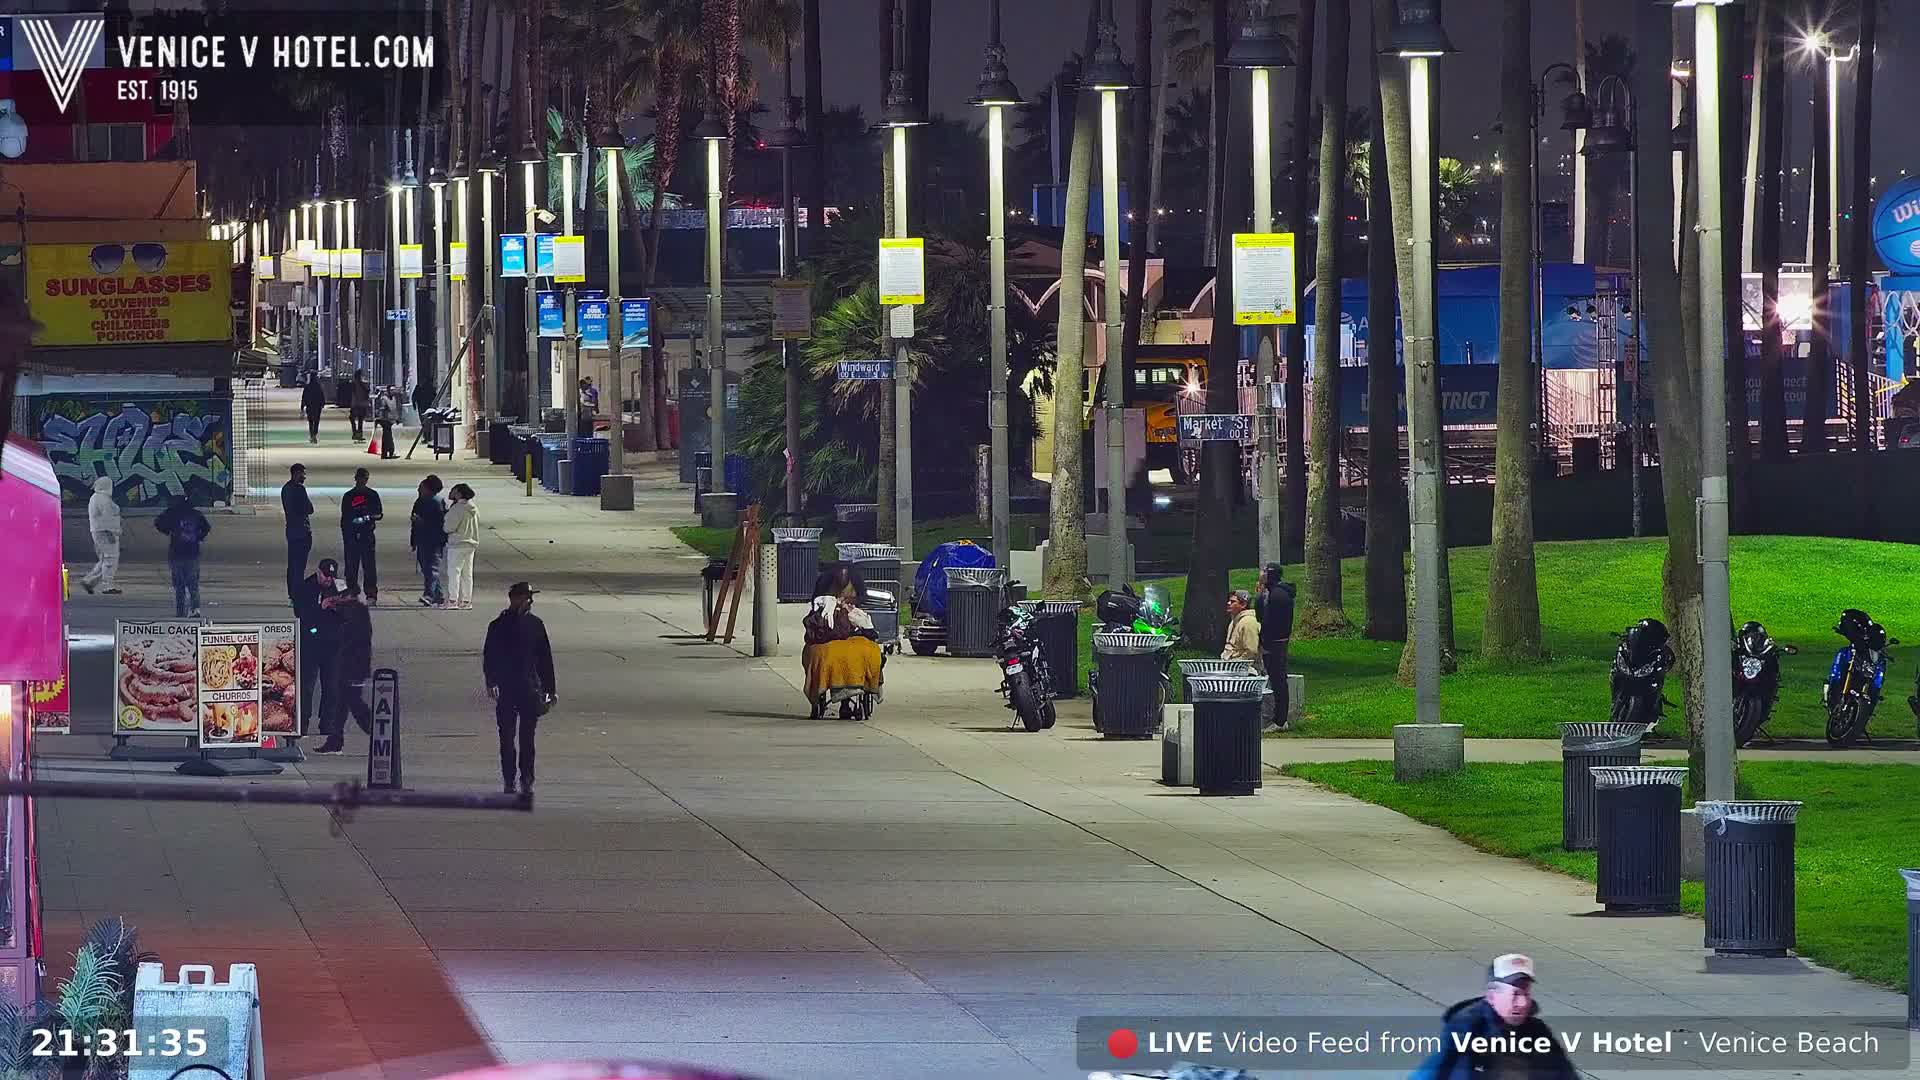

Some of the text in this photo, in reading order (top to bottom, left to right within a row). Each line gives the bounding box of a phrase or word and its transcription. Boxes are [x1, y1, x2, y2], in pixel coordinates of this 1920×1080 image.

[1892, 199, 1920, 223] Wi
[46, 274, 212, 296] SUNGLASSES
[89, 296, 170, 309] SOUVENIRS
[103, 308, 159, 320] TOWELS
[91, 319, 170, 331] CHILDRENS
[96, 330, 165, 341] PONCHOS
[840, 362, 880, 371] Windward
[1441, 391, 1490, 410] TRICT
[1183, 416, 1249, 430] Market St
[1229, 429, 1249, 439] 00 E
[122, 625, 197, 635] FUNNEL CAKE
[264, 625, 292, 633] OREOS
[202, 635, 258, 644] FUNNEL CAKE
[212, 692, 251, 701] CHURROS
[374, 697, 391, 757] ATM
